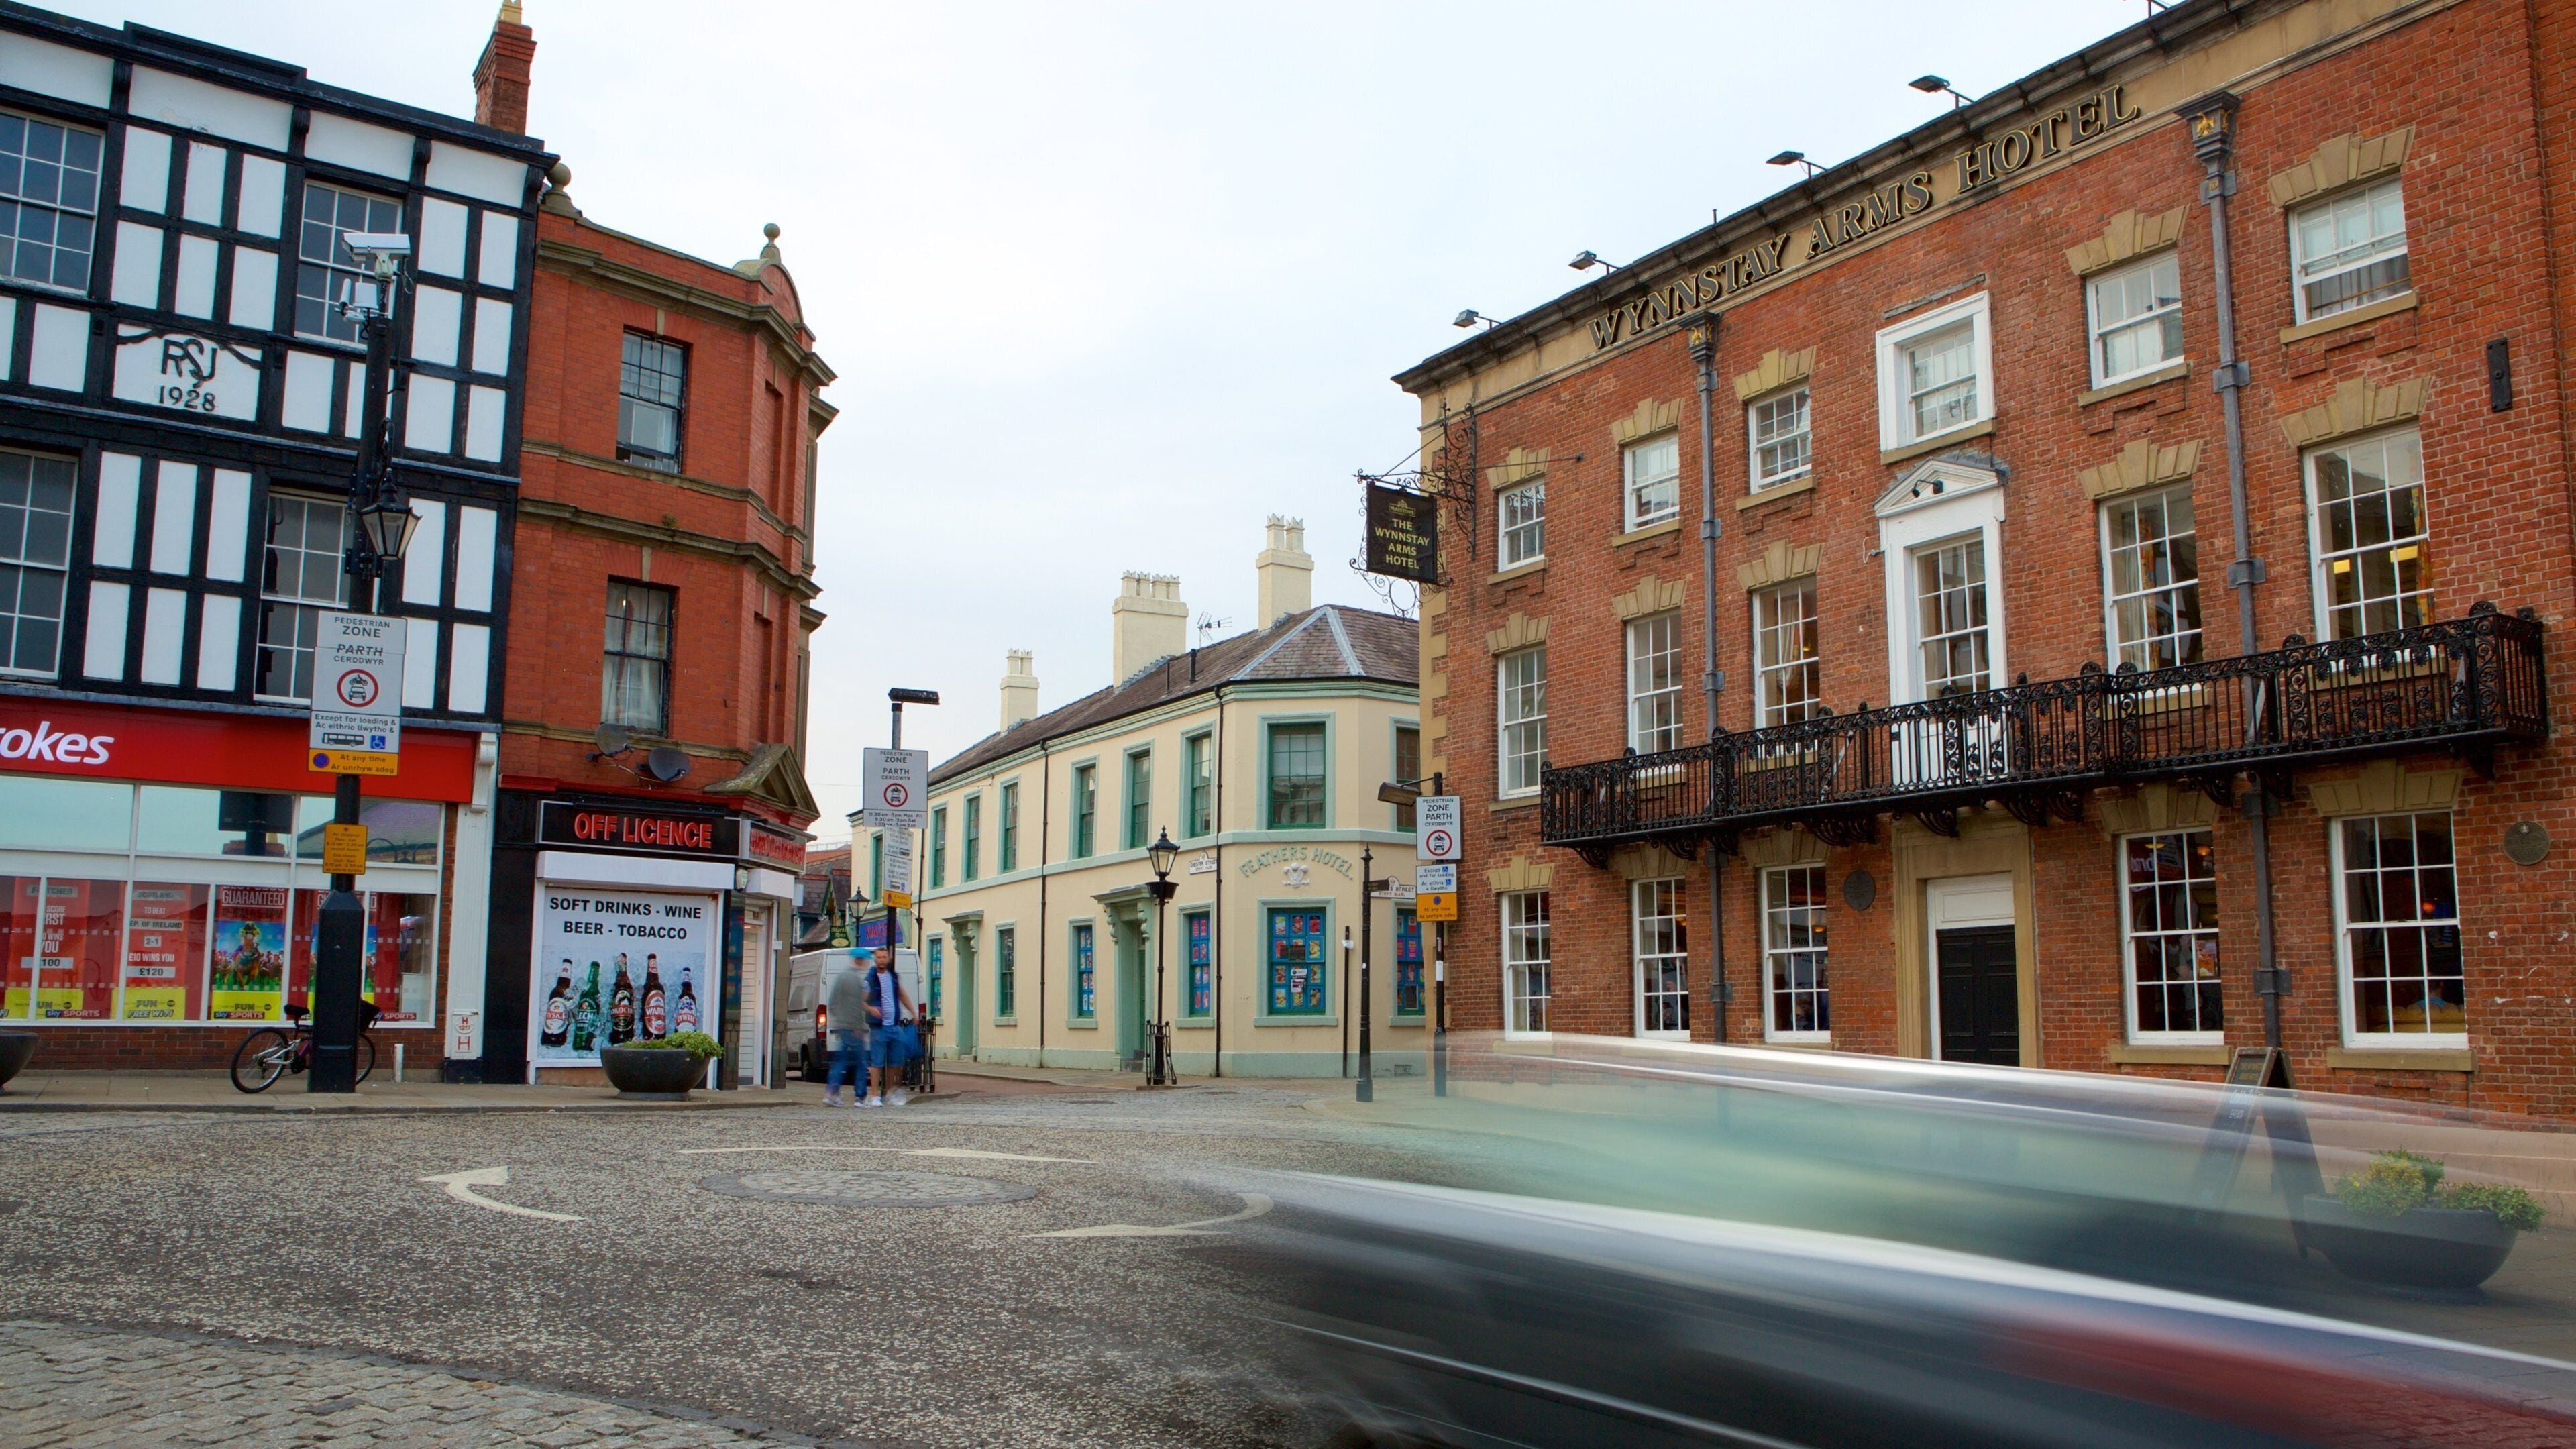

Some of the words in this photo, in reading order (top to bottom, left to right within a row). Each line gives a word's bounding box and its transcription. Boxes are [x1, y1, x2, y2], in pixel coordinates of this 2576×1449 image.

[1586, 233, 1790, 350] WYNNSTAY
[1805, 172, 1931, 258] ARMS
[1955, 85, 2139, 193] HOTEL
[159, 385, 218, 412] 1928
[1391, 518, 1413, 531] THE
[1375, 527, 1430, 547] WYNNSTAY
[1388, 542, 1417, 556] ARMS
[1385, 554, 1419, 569] HOTEL
[335, 616, 390, 628] PEDESTRIAN
[342, 625, 381, 638] ZONE
[336, 643, 384, 657] PARTH
[333, 655, 384, 665] CERDDWYR
[315, 714, 343, 722] Except
[360, 717, 388, 726] loading
[357, 724, 387, 733] llwytho
[0, 720, 115, 765] okes
[343, 765, 372, 773] unrhyw
[574, 812, 618, 840] OFF
[623, 817, 712, 848] LICENCE
[1239, 845, 1307, 877] FEATHERS
[222, 890, 285, 906] GUARANTEED
[549, 897, 590, 912] SOFT
[595, 900, 651, 916] DRINKS
[664, 905, 701, 919] WINE
[45, 913, 65, 925] RST
[564, 920, 604, 935] BEER
[618, 924, 687, 940] TOBACCO
[40, 959, 60, 967] 100
[129, 953, 141, 961] £10
[142, 953, 160, 962] WINS
[162, 954, 174, 962] YOU
[139, 967, 164, 976] £120
[136, 1000, 158, 1008] FUN
[127, 1010, 150, 1018] FREE
[458, 1036, 470, 1051] H
